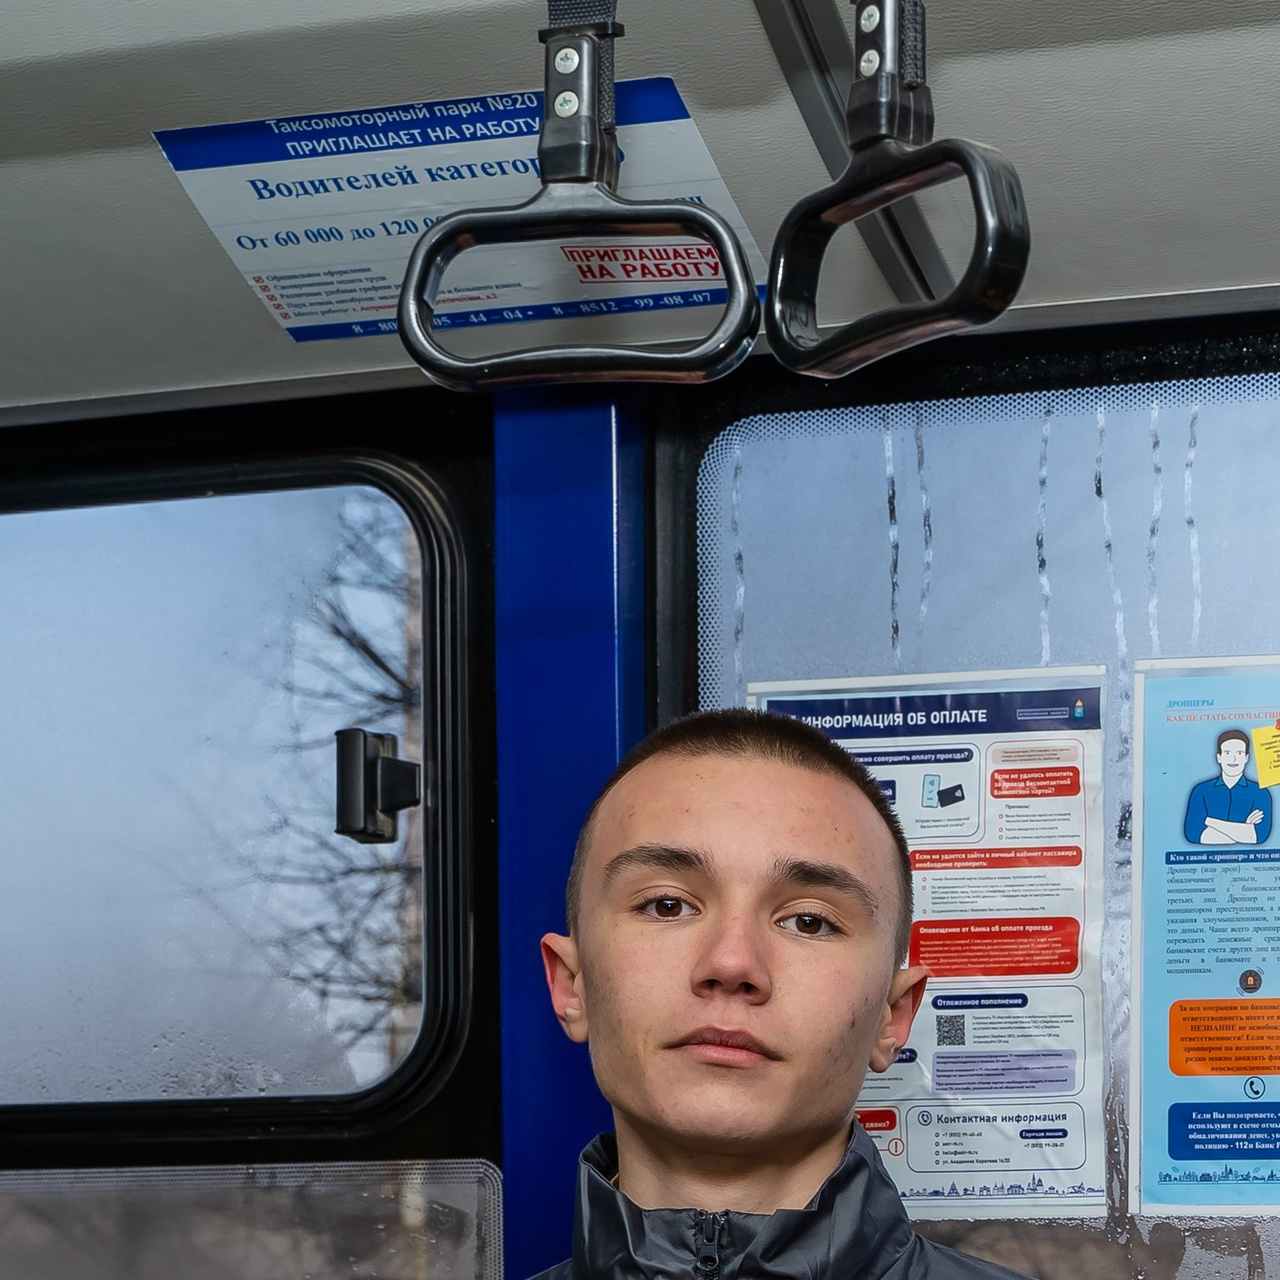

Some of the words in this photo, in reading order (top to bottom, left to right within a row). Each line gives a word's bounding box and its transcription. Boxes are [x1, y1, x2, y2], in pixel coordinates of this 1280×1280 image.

[266, 105, 430, 134] Таксомоторный
[434, 101, 484, 117] парк
[486, 93, 538, 111] №20
[286, 129, 423, 156] ПРИГЛАШАЕТ
[427, 124, 460, 142] НА
[464, 117, 540, 138] РАБОТУ
[247, 166, 419, 200] Водителей
[236, 235, 267, 251] От
[275, 231, 300, 247] 60
[304, 227, 344, 243] 000
[352, 227, 375, 241] до
[380, 220, 419, 237] 120
[568, 246, 716, 262] ПРИГЛАШАЕМ
[579, 262, 611, 279] НА
[624, 261, 720, 278] РАБОТУ
[365, 276, 387, 285] труда
[469, 314, 487, 324] 44
[503, 310, 521, 319] 04
[553, 306, 563, 315] 8
[580, 301, 619, 312] 8512
[634, 297, 654, 307] 99
[352, 325, 363, 333] 8
[1166, 700, 1214, 708] ДРОППЕРЫ
[801, 713, 903, 728] ИНФОРМАЦИЯ
[908, 713, 926, 724] ОБ
[931, 710, 987, 723] ОПЛАТЕ
[1200, 713, 1227, 721] СТАТЬ
[874, 754, 910, 763] совершить
[937, 752, 968, 760] проезда?
[937, 1115, 997, 1124] Контактная
[1001, 1114, 1066, 1124] информация
